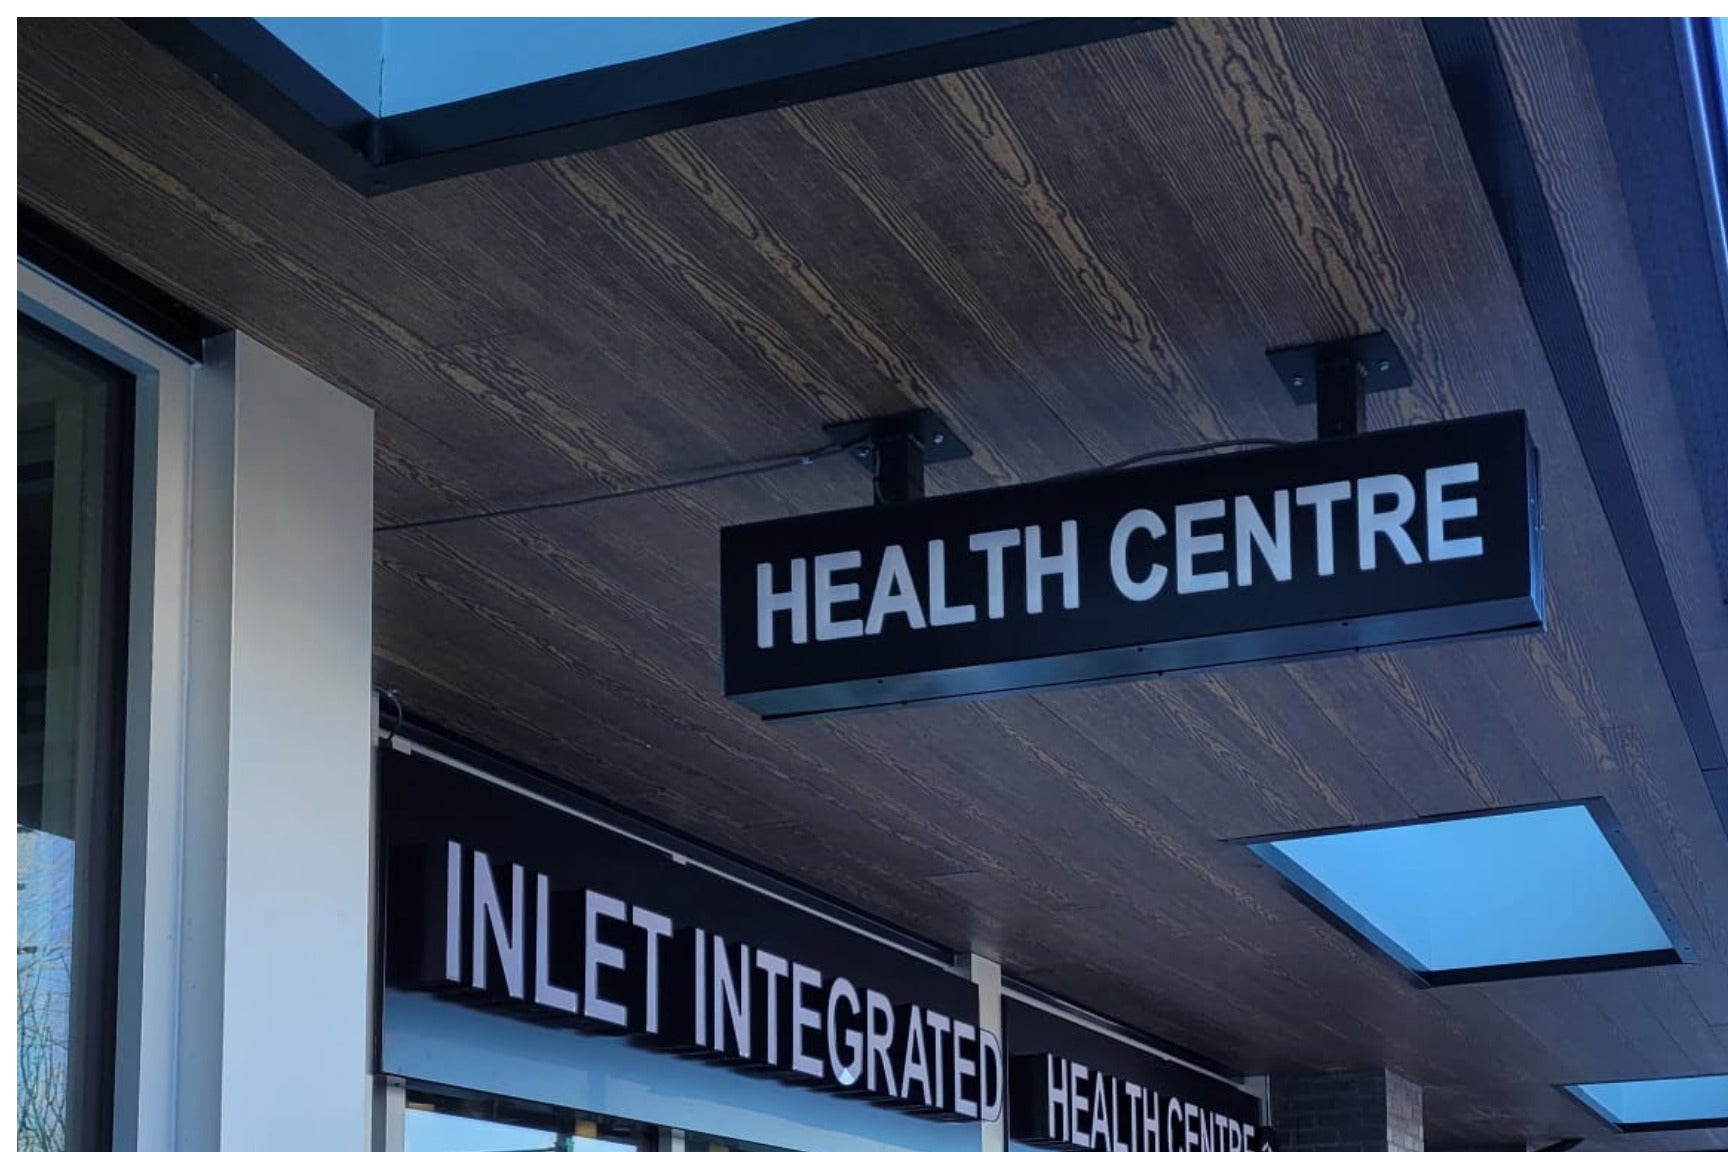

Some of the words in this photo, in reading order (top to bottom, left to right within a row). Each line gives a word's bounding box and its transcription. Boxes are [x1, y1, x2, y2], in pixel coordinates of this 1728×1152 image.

[756, 519, 1080, 649] HEALTH
[1109, 461, 1484, 601] CENTRE
[445, 840, 673, 1034] INLET
[694, 928, 1001, 1121] INTEGRATED
